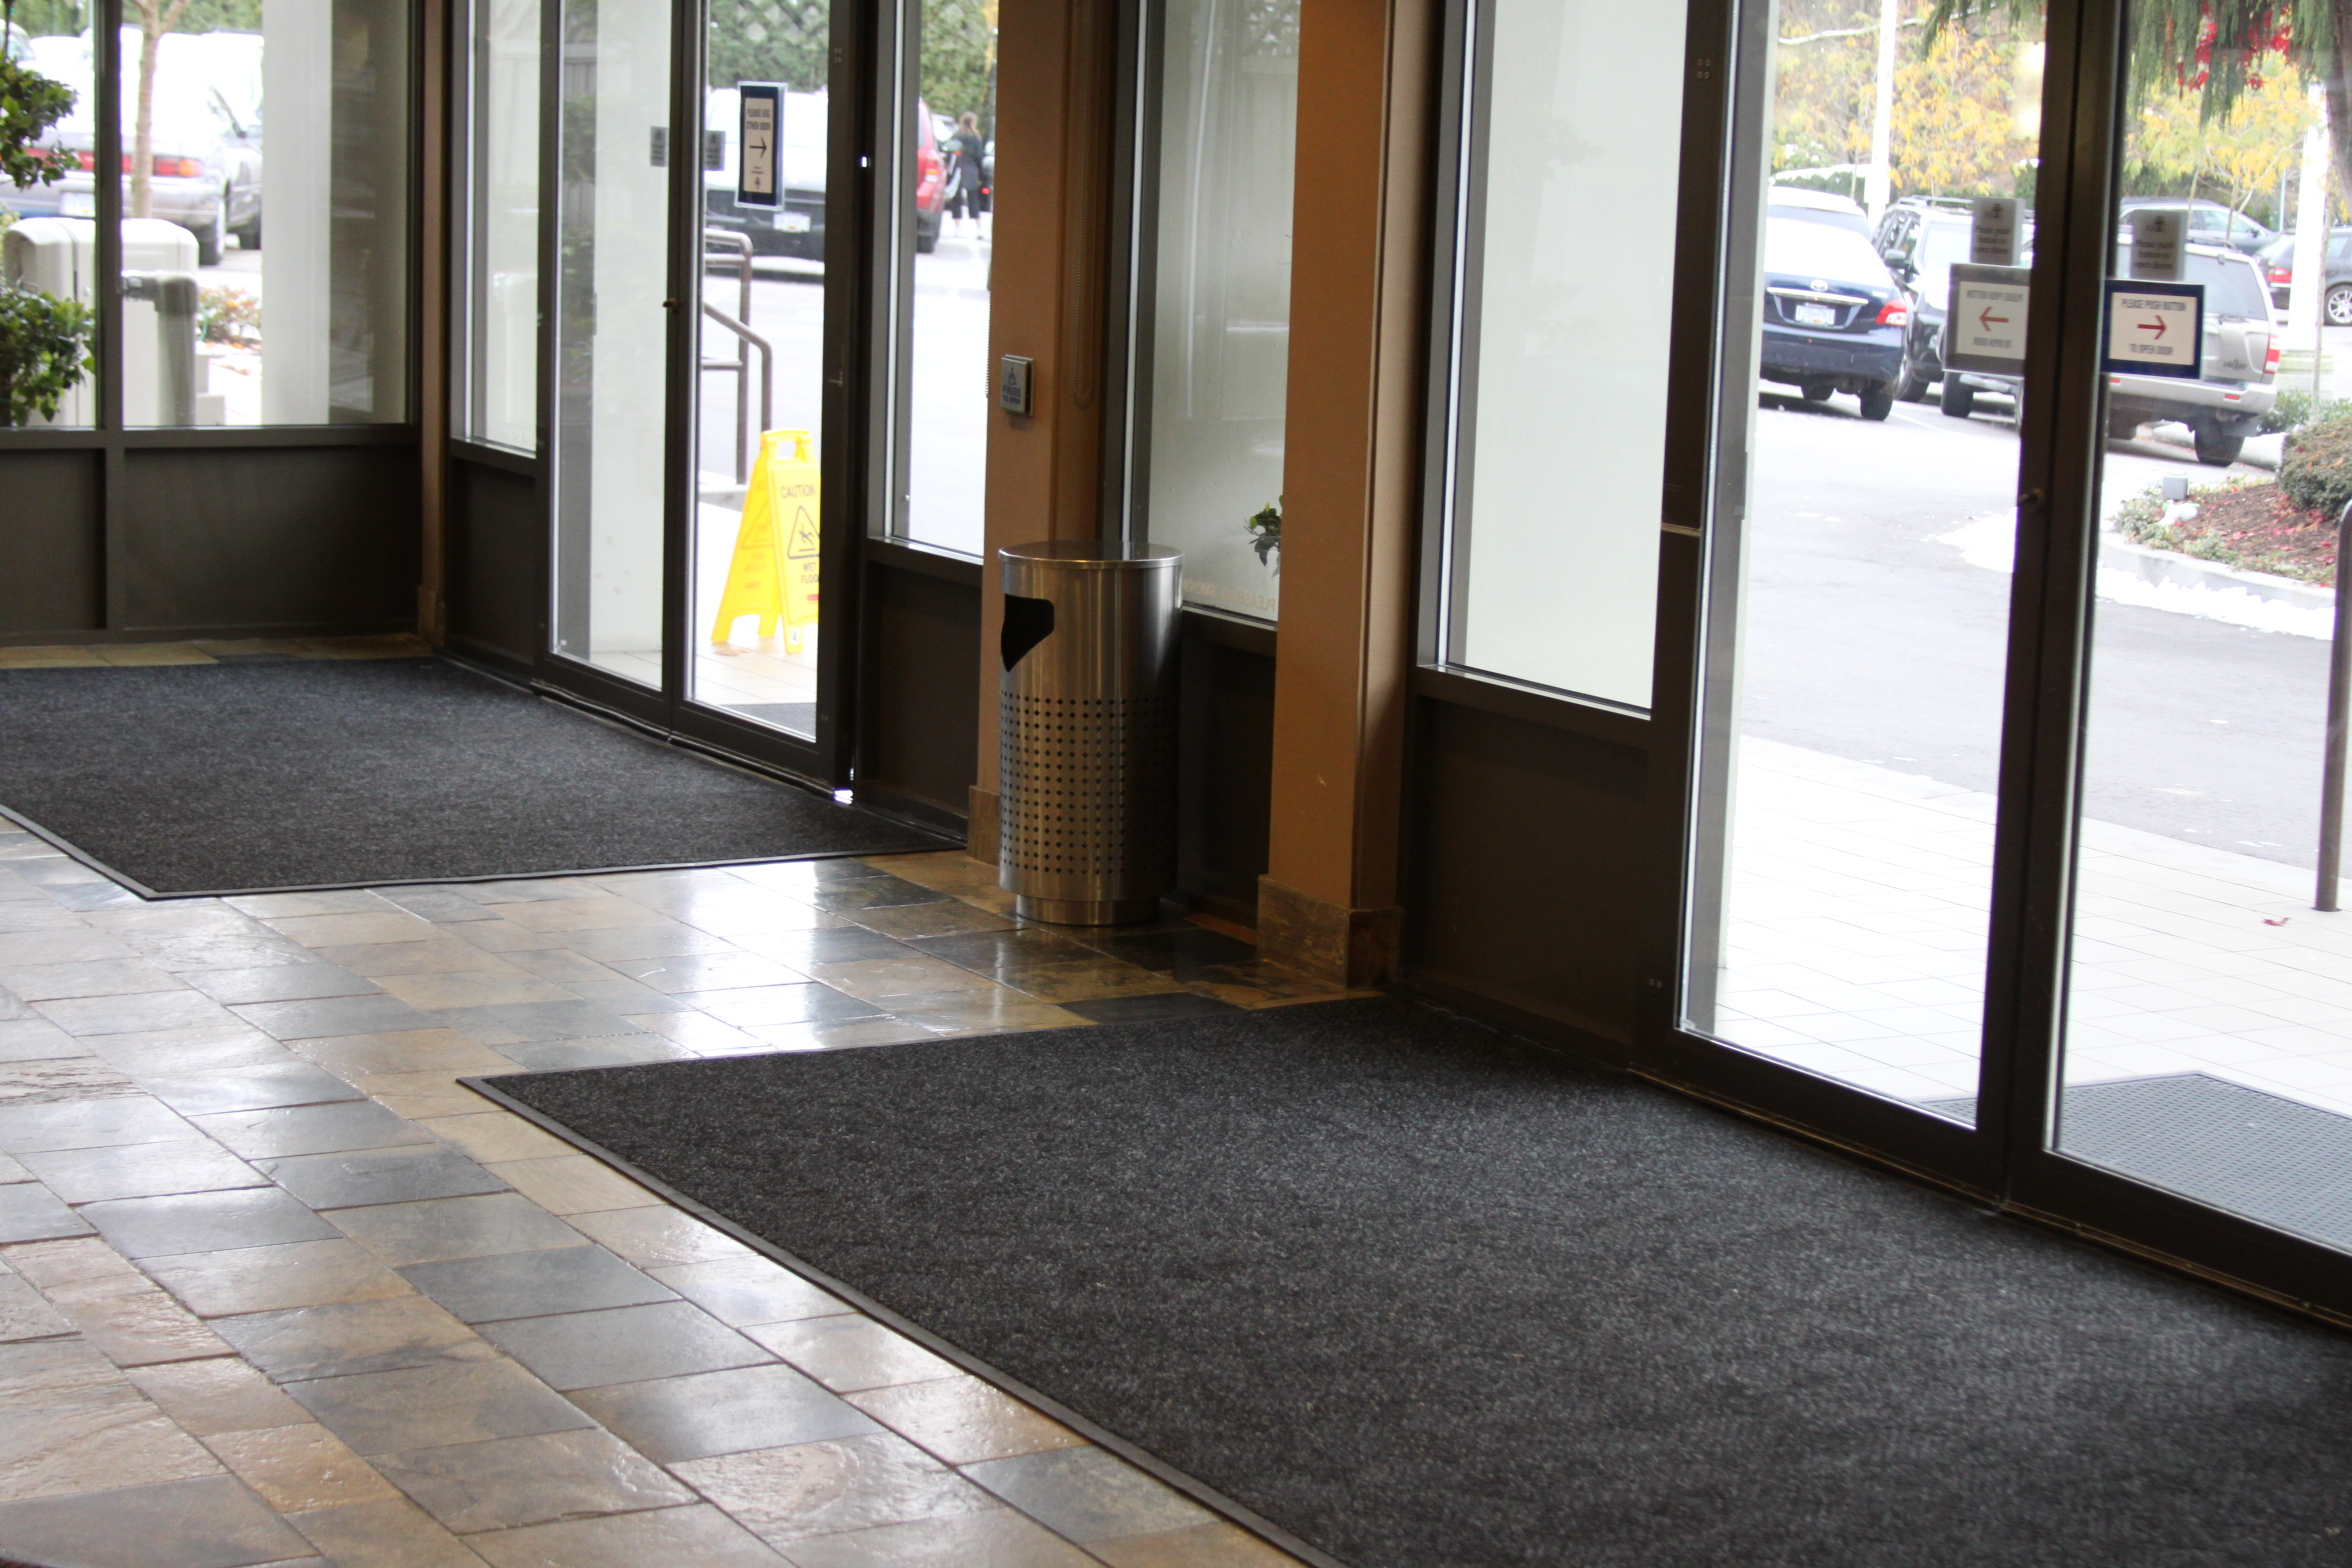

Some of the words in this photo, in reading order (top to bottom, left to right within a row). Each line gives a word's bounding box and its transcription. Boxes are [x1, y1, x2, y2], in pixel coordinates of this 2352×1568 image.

[2121, 298, 2145, 309] PLEASE
[2145, 300, 2161, 310] PUSH
[2163, 301, 2187, 312] BUTTON
[2129, 343, 2138, 353] TO
[2139, 344, 2155, 355] OPEN
[2156, 345, 2174, 356] DOOR
[1003, 384, 1021, 398] PRESS
[781, 484, 816, 498] CAUTION
[803, 562, 817, 572] WET
[801, 573, 819, 584] FLOO
